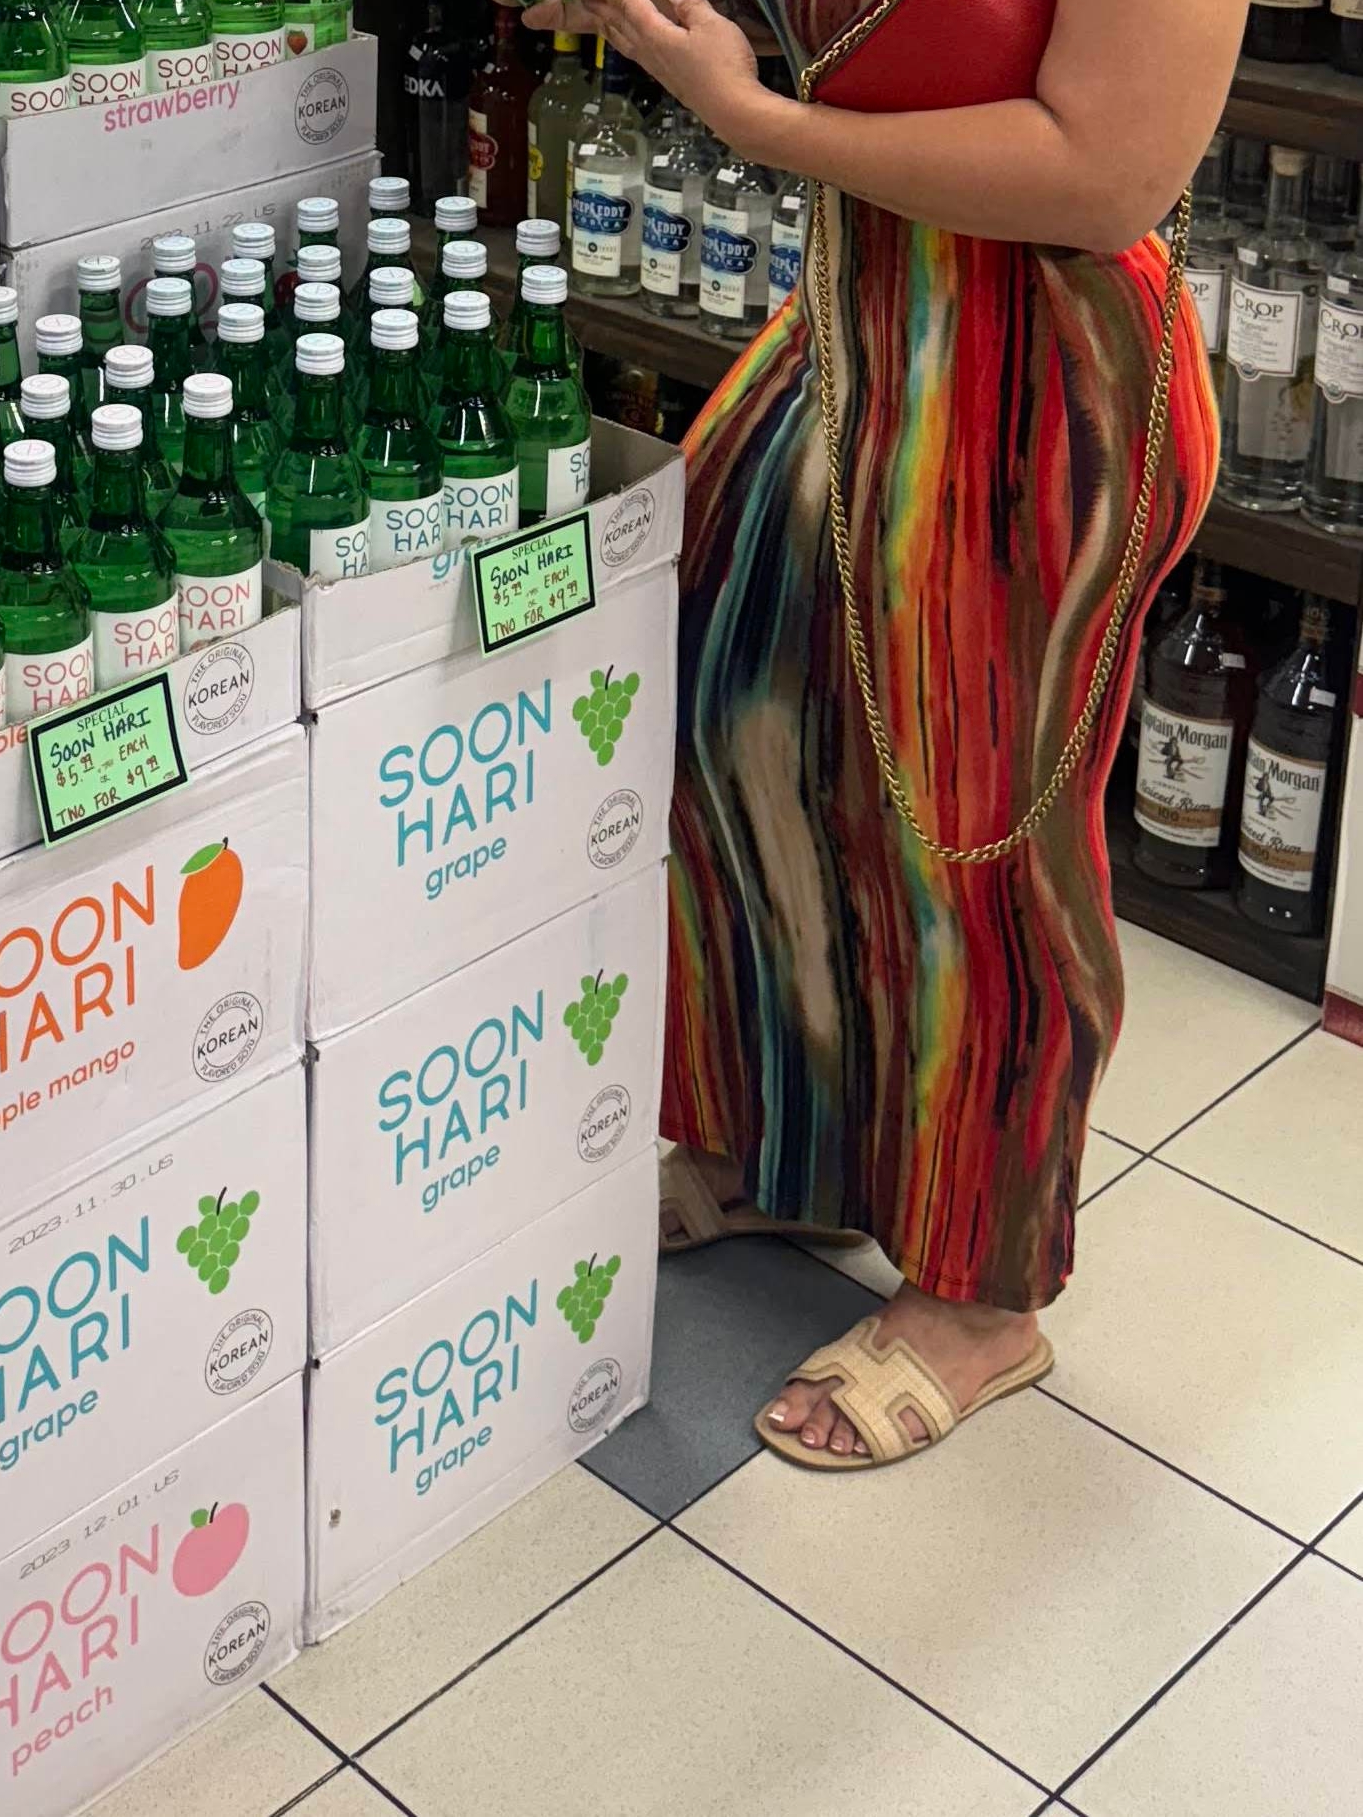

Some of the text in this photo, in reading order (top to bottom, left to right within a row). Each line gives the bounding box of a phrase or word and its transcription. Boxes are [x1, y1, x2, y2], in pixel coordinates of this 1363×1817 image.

[104, 78, 239, 133] strawberry
[299, 96, 345, 118] KOREAN
[444, 480, 513, 507] SOON
[448, 504, 508, 530] HARI
[605, 511, 651, 544] KOREAN
[512, 535, 555, 560] SPECIAL
[544, 566, 569, 588] EACH
[492, 607, 546, 640] TWO FOR
[189, 670, 249, 708] KOREAN
[77, 702, 129, 732] SPECIAL
[104, 707, 151, 742] HARI
[119, 734, 149, 761] EACH
[379, 679, 551, 808] SOON
[1176, 723, 1228, 750] Morgan
[1268, 761, 1320, 792] Morgan
[57, 786, 121, 825] TWO FOR
[398, 750, 534, 867] HARI
[591, 812, 640, 847] KOREAN
[426, 837, 506, 900] grape
[196, 1015, 259, 1059] KOREAN
[48, 1041, 135, 1099] mango
[378, 989, 543, 1132] SOON
[396, 1059, 527, 1185] HARI
[580, 1106, 627, 1143] KOREAN
[422, 1145, 500, 1213] grape
[209, 1329, 269, 1375] KOREAN
[375, 1279, 537, 1425] SOON
[391, 1344, 519, 1474] HARI
[571, 1377, 618, 1414] KOREAN
[416, 1426, 492, 1495] grape
[12, 1686, 114, 1776] peach
